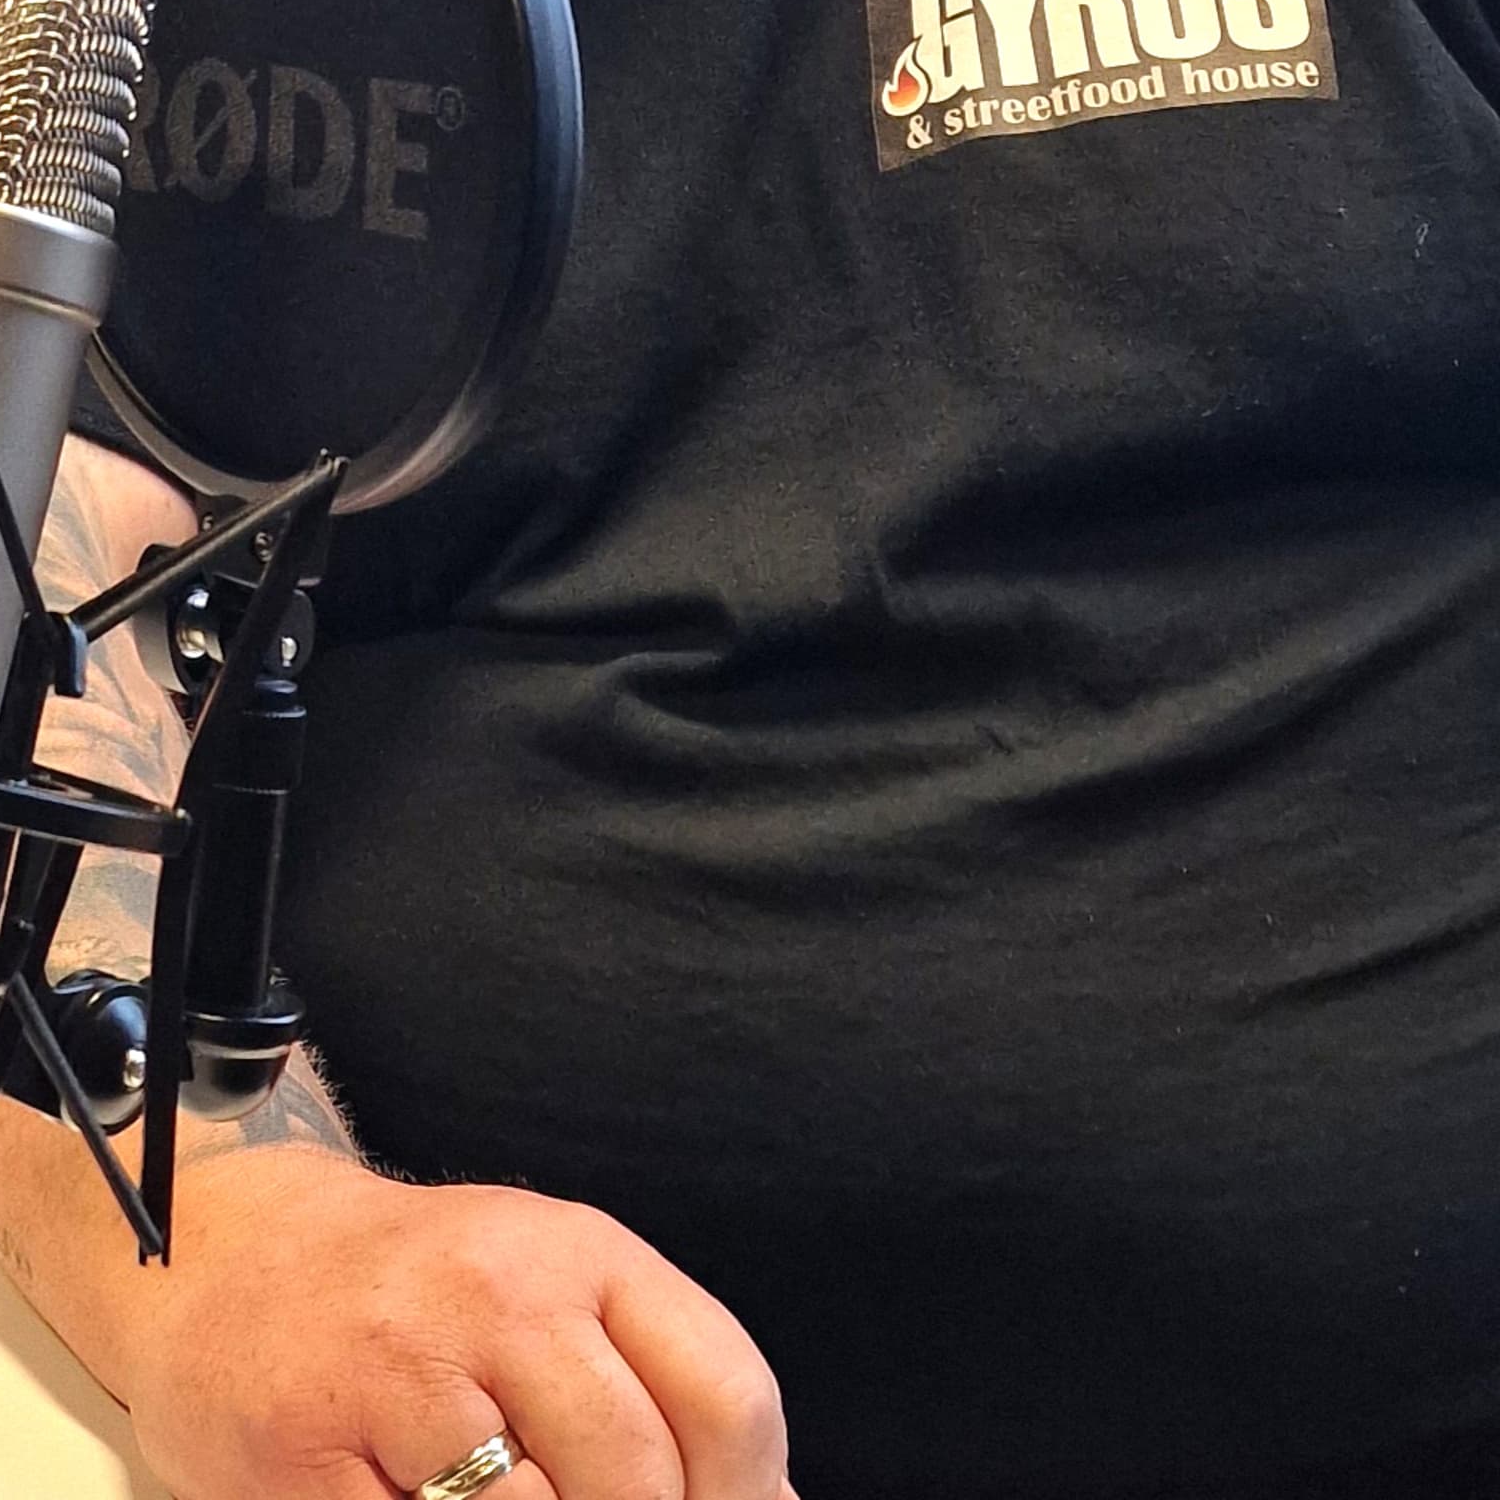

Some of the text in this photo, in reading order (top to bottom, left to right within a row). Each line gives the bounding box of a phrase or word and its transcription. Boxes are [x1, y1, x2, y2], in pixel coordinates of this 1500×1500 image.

[906, 56, 1320, 150] & streetfood house
